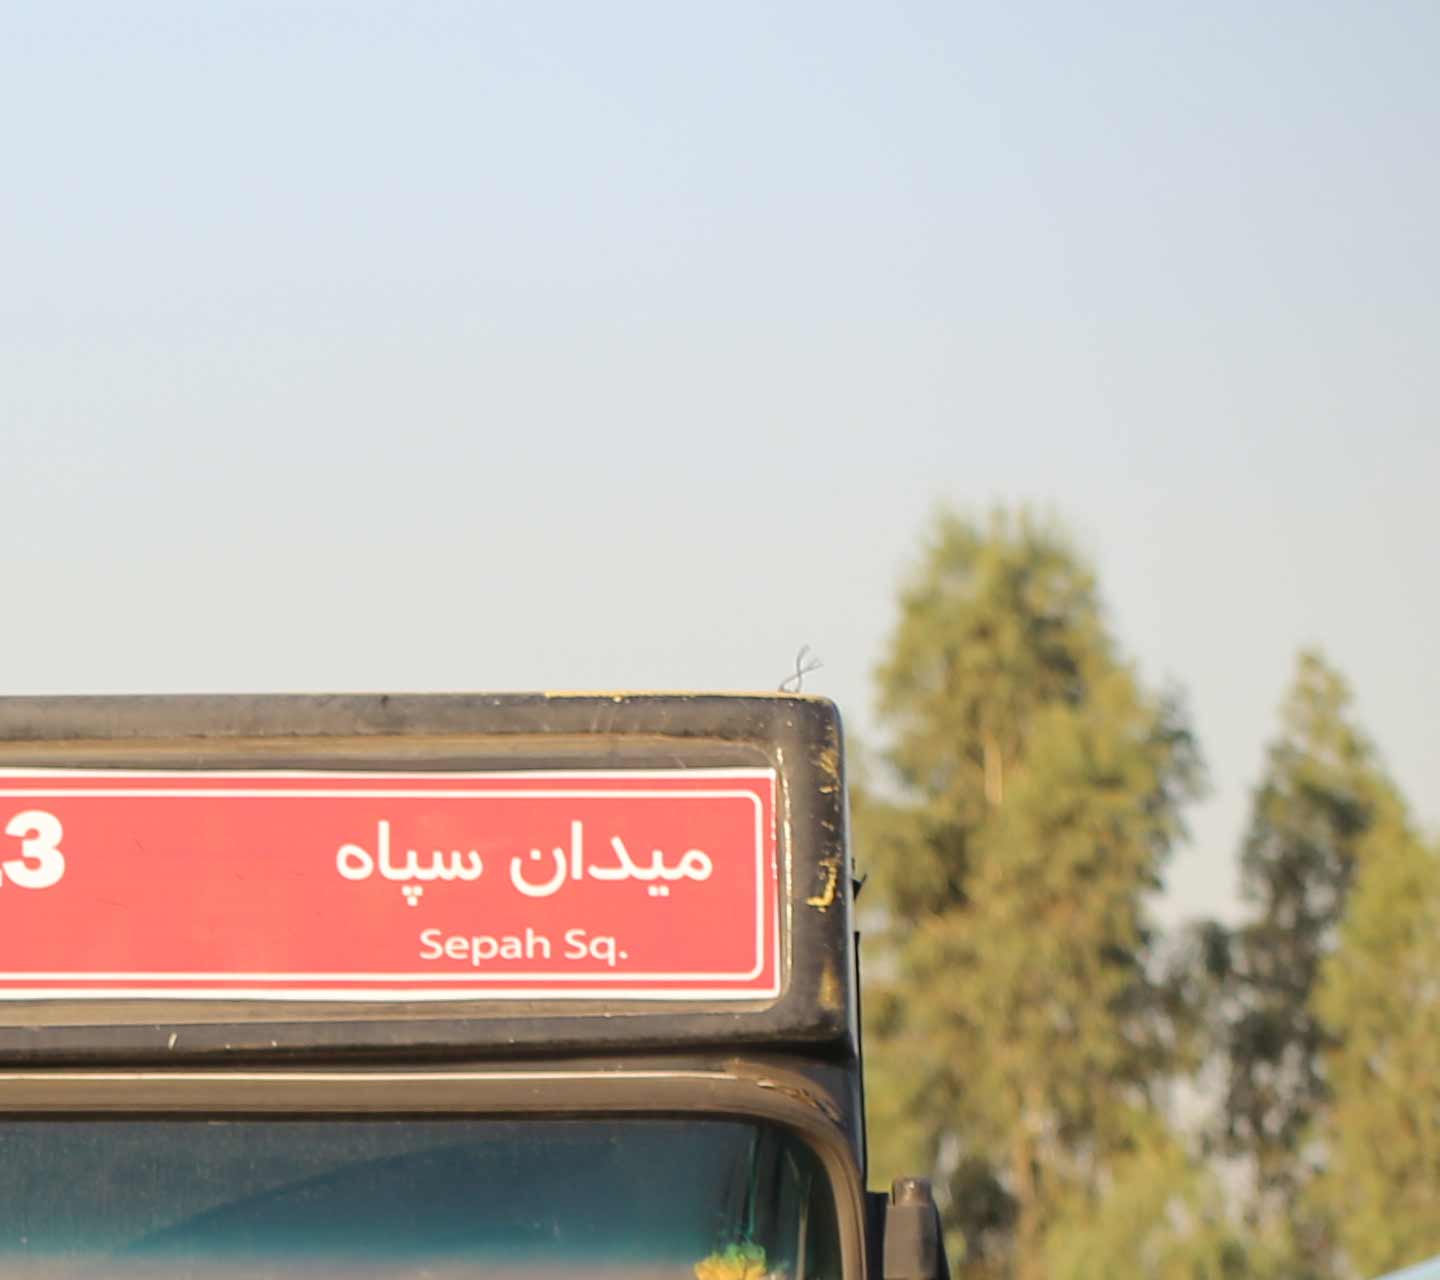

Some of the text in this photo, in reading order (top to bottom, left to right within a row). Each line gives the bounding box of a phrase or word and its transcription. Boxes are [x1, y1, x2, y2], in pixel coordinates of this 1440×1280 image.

[335, 820, 713, 907] میدان سپاه
[418, 928, 629, 967] Sepah Sq.
